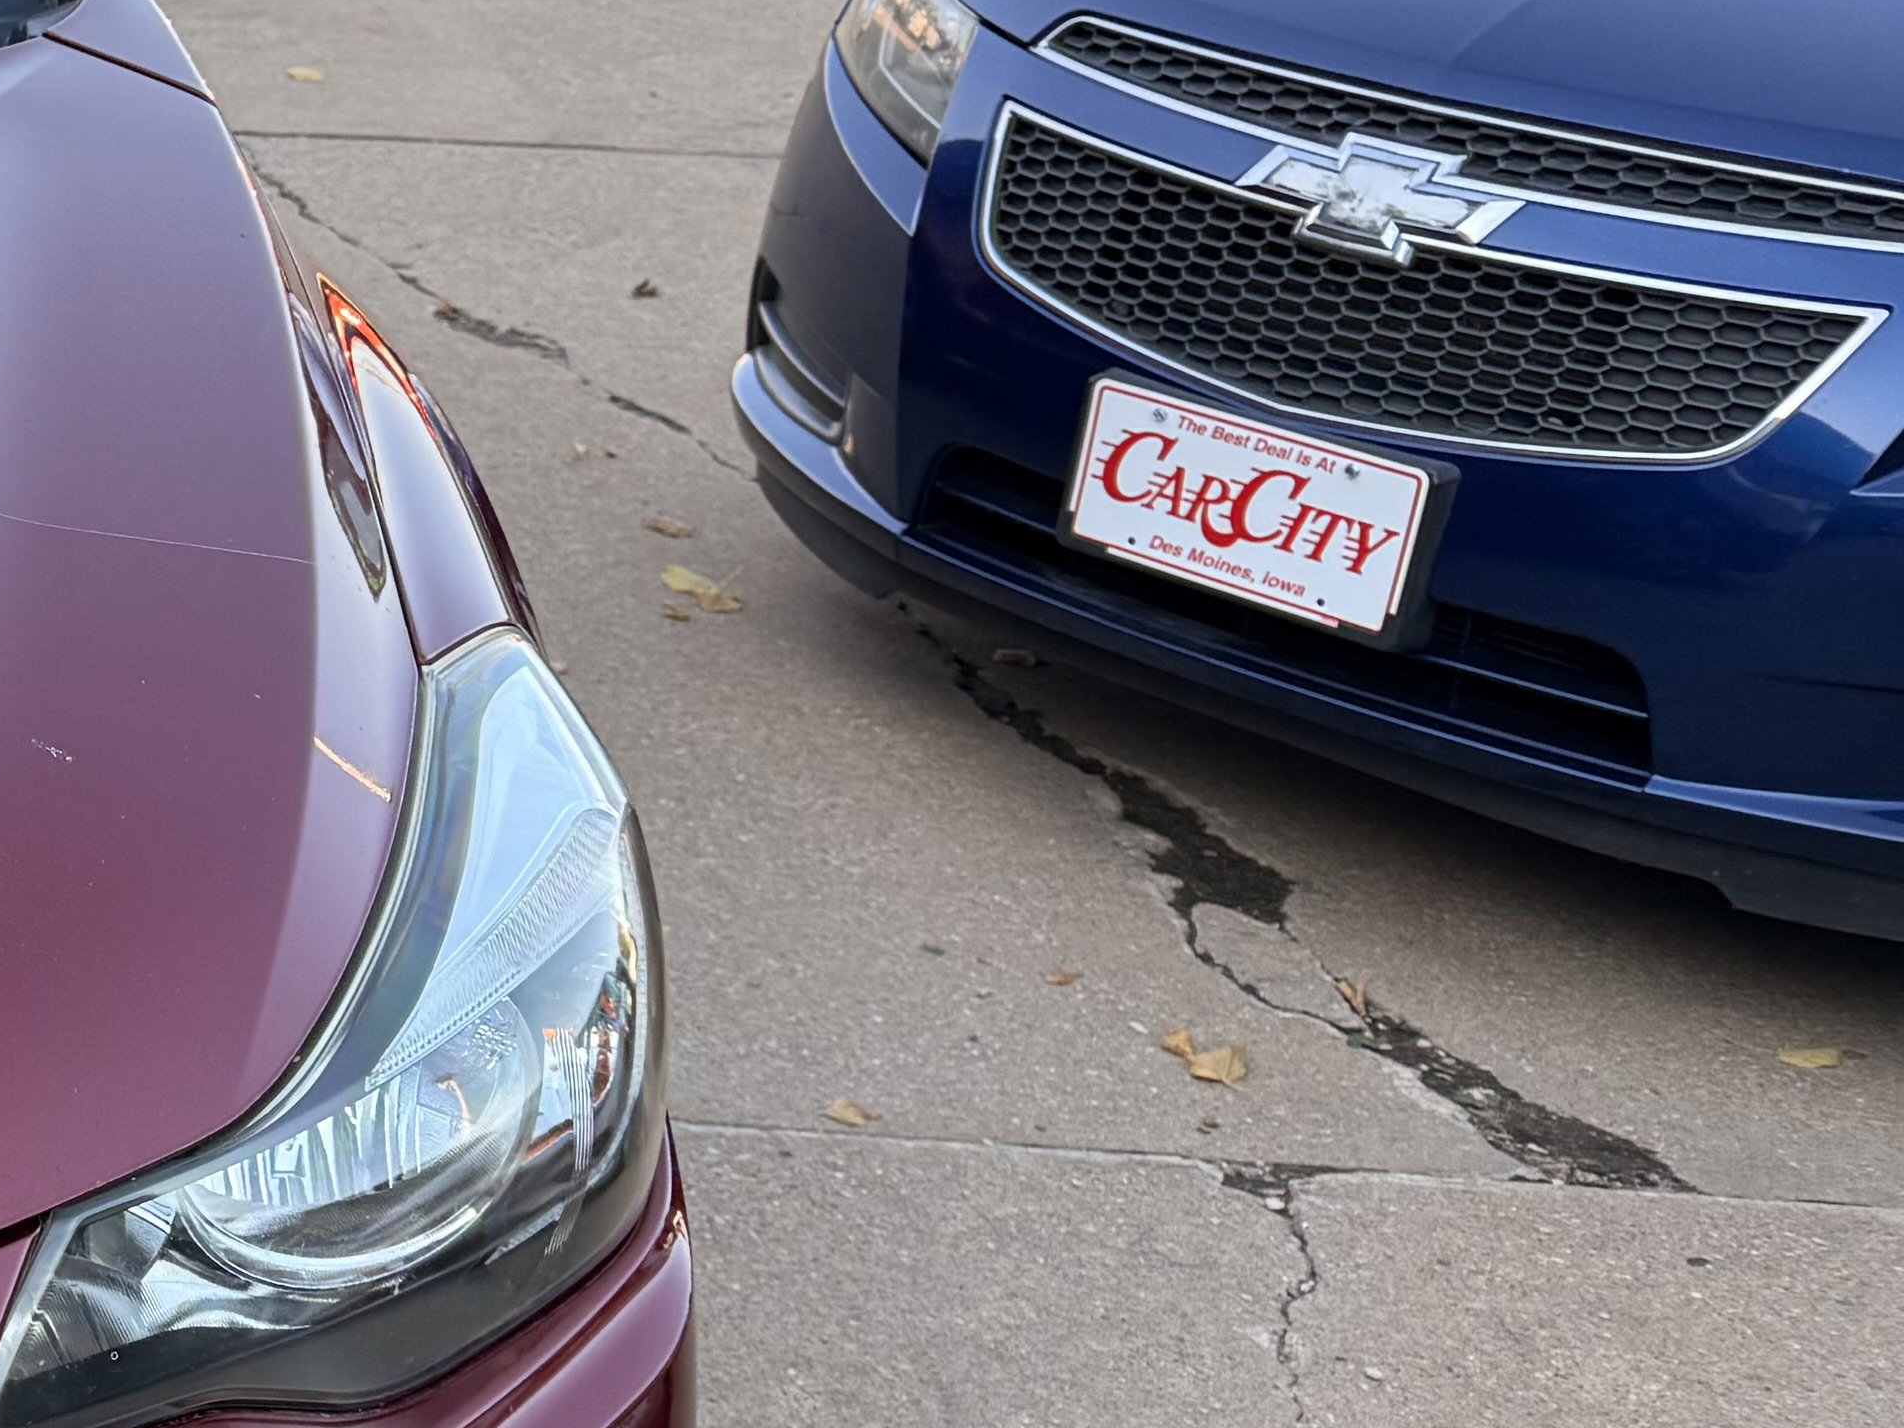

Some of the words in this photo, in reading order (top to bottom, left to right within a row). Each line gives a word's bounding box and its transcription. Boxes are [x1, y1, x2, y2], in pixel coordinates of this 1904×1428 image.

[1177, 414, 1208, 437] The
[1210, 425, 1252, 450] Best
[1253, 437, 1294, 462] Deal
[1295, 449, 1314, 468] Is
[1314, 456, 1337, 475] At
[1148, 534, 1185, 559] Des
[1186, 547, 1256, 584] Moines,
[1260, 570, 1307, 598] Iowa
